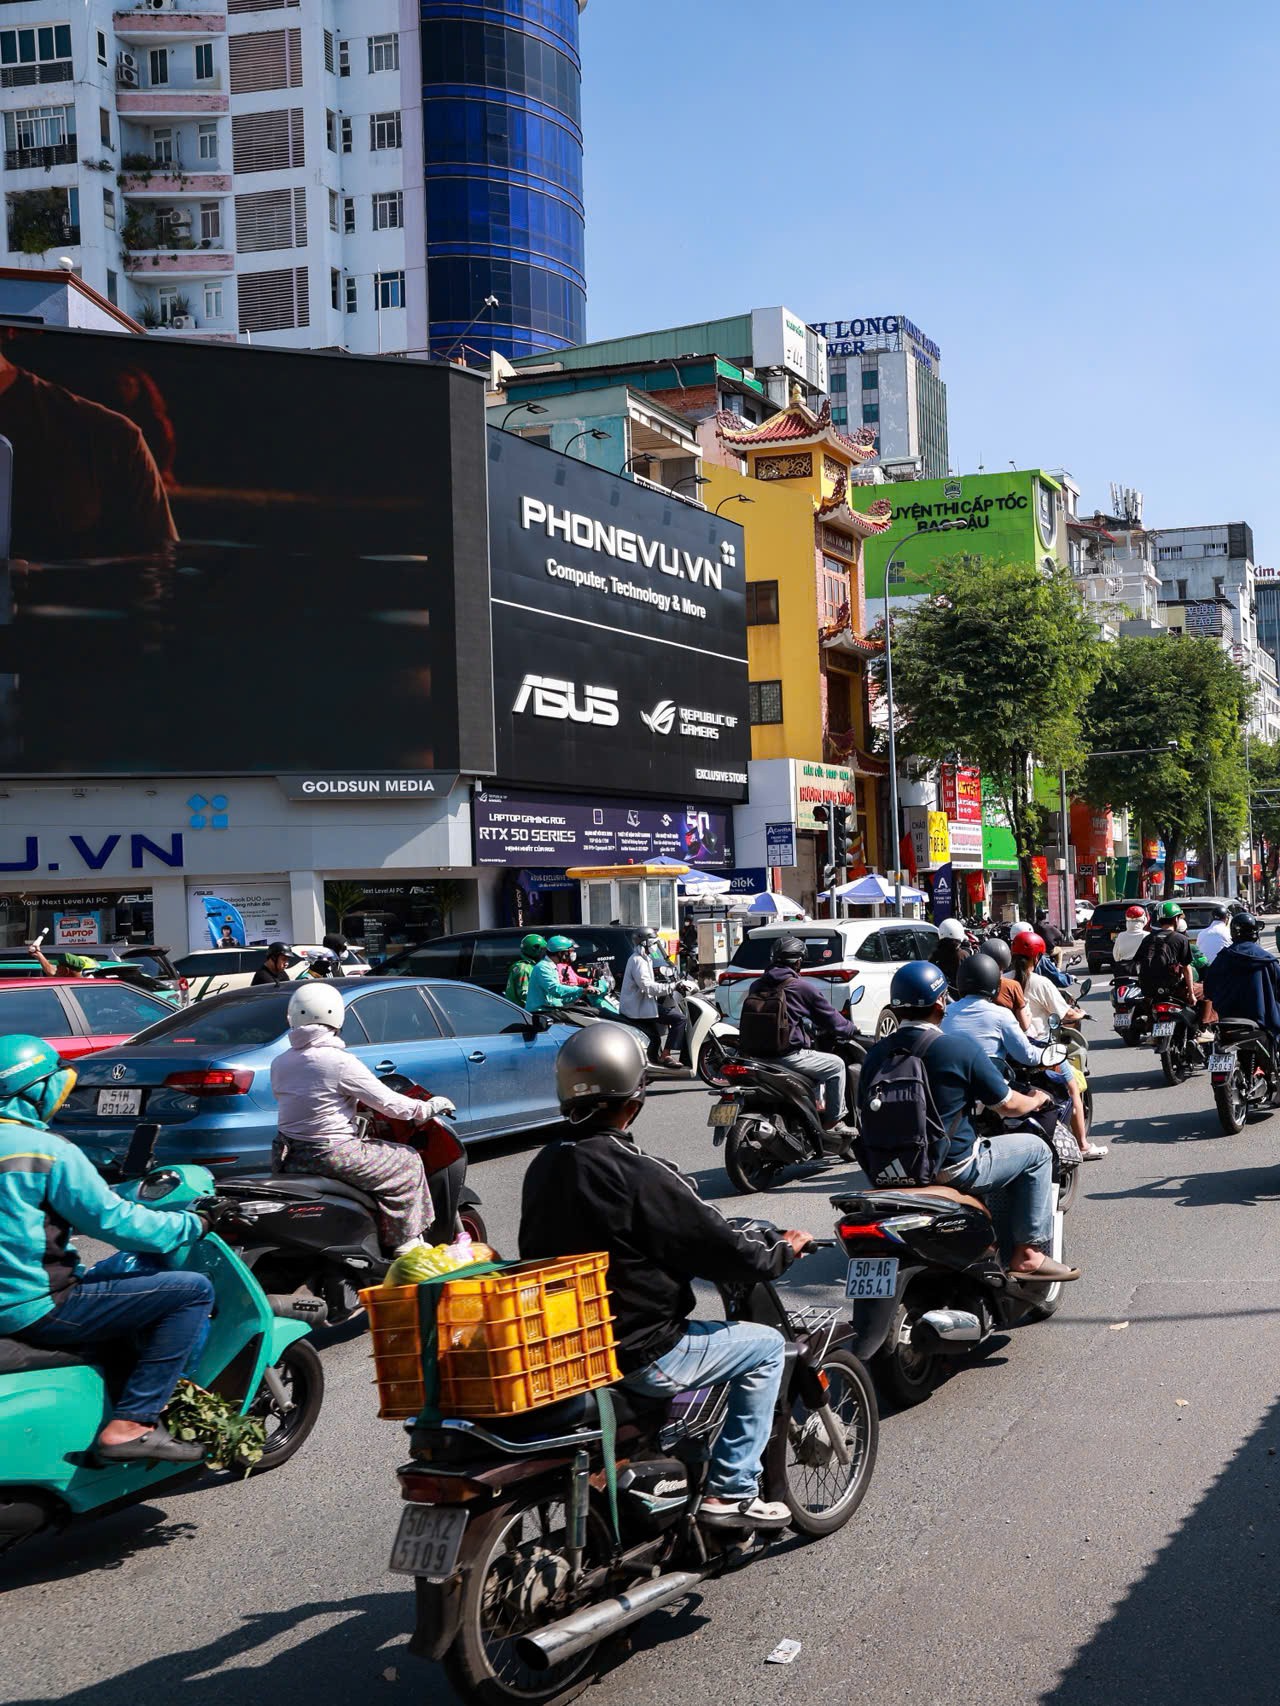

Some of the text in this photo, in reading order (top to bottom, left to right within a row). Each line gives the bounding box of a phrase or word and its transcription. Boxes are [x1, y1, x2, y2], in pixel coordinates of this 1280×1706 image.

[835, 316, 899, 339] LONG
[933, 502, 959, 516] THI
[961, 495, 993, 513] CẤP
[996, 491, 1028, 511] TỐC
[520, 495, 723, 591] PHONGVU.VN
[546, 558, 707, 619] Computer, Technology & More
[511, 673, 619, 727] ASUS
[679, 706, 738, 728] REPUBLIC OF
[680, 723, 720, 739] GAMERS
[695, 768, 748, 784] EXCLUSIVE STORE
[302, 779, 436, 794] GOLDSUN MEDIA
[489, 813, 521, 823] LAPTOP
[550, 817, 566, 825] ROG
[479, 827, 509, 840] RTX
[510, 828, 529, 841] 50
[531, 829, 576, 843] SERIES
[96, 896, 108, 904] PC
[101, 1103, 135, 1115] 891.22
[875, 1176, 917, 1185] adidas
[849, 1278, 893, 1296] 265.41
[398, 1540, 448, 1571] 5109
